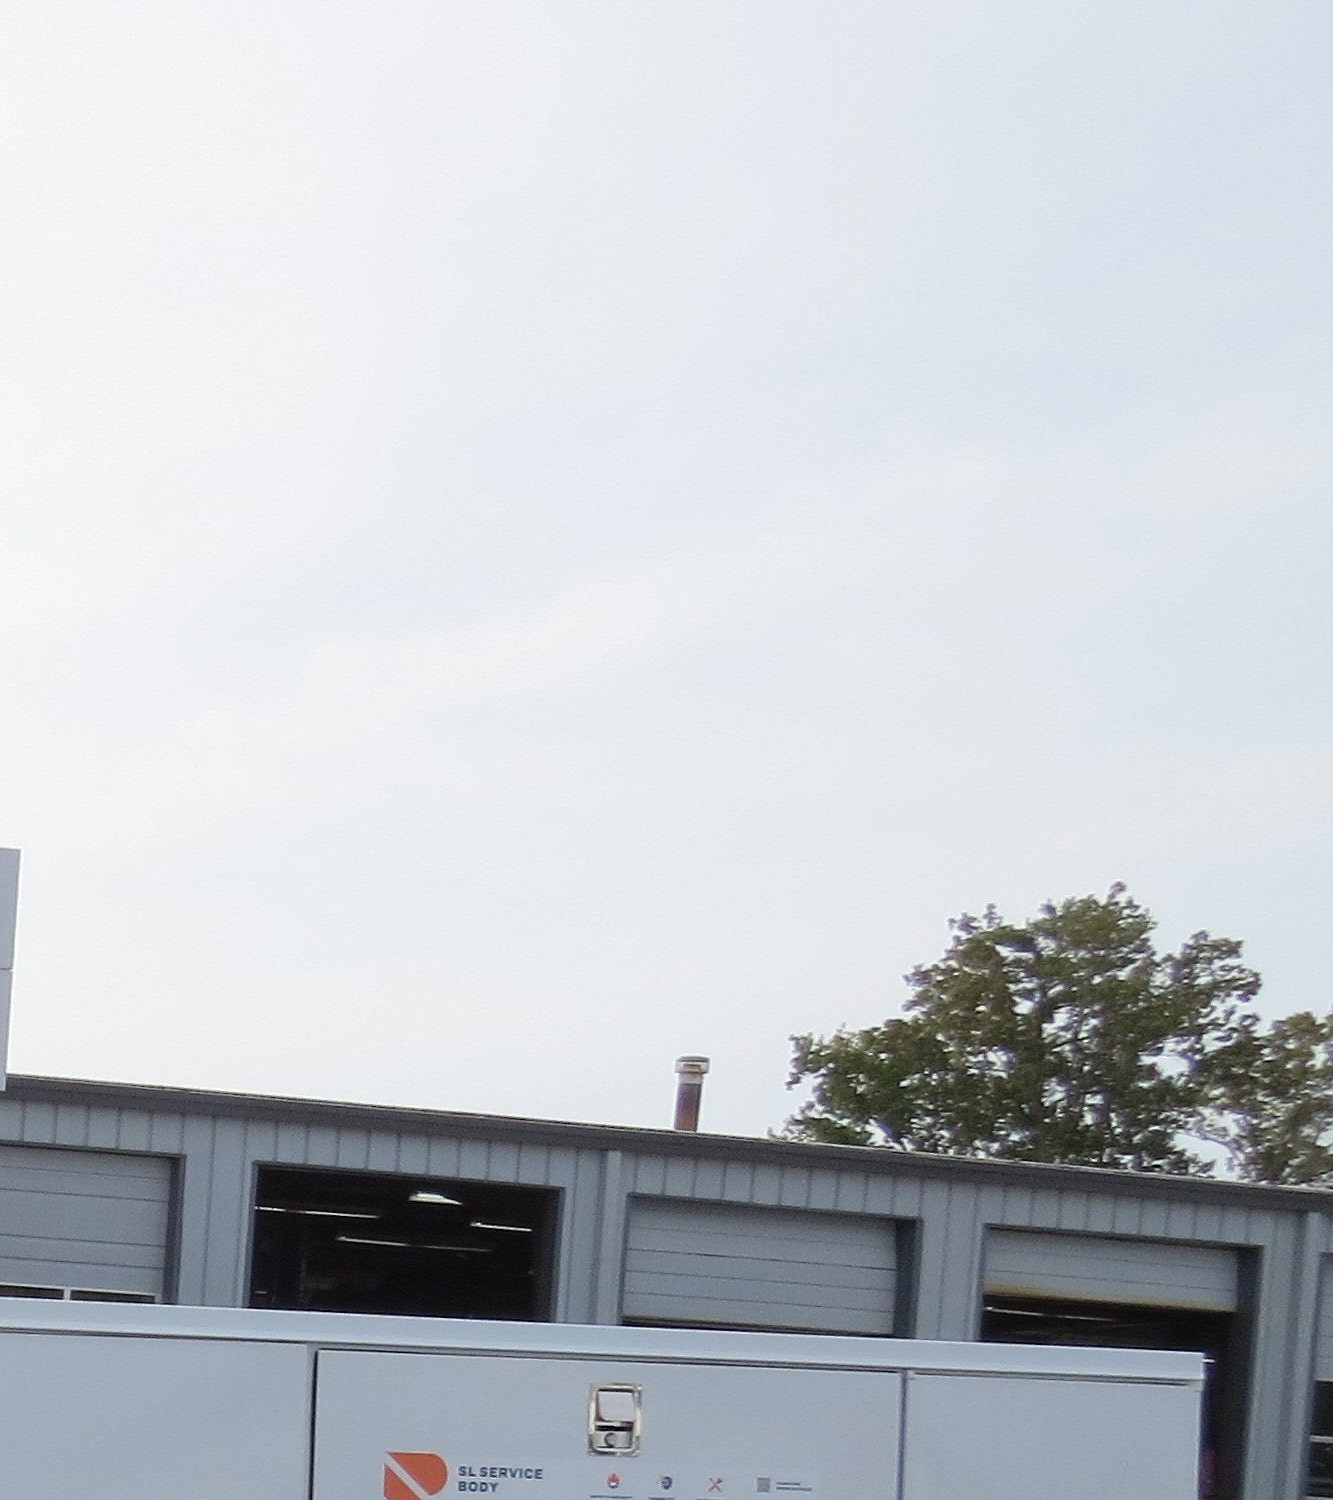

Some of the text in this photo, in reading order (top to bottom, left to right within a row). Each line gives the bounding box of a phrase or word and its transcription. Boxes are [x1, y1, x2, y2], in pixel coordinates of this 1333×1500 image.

[457, 1466, 543, 1479] SL SERVICE
[457, 1481, 499, 1492] BODY
